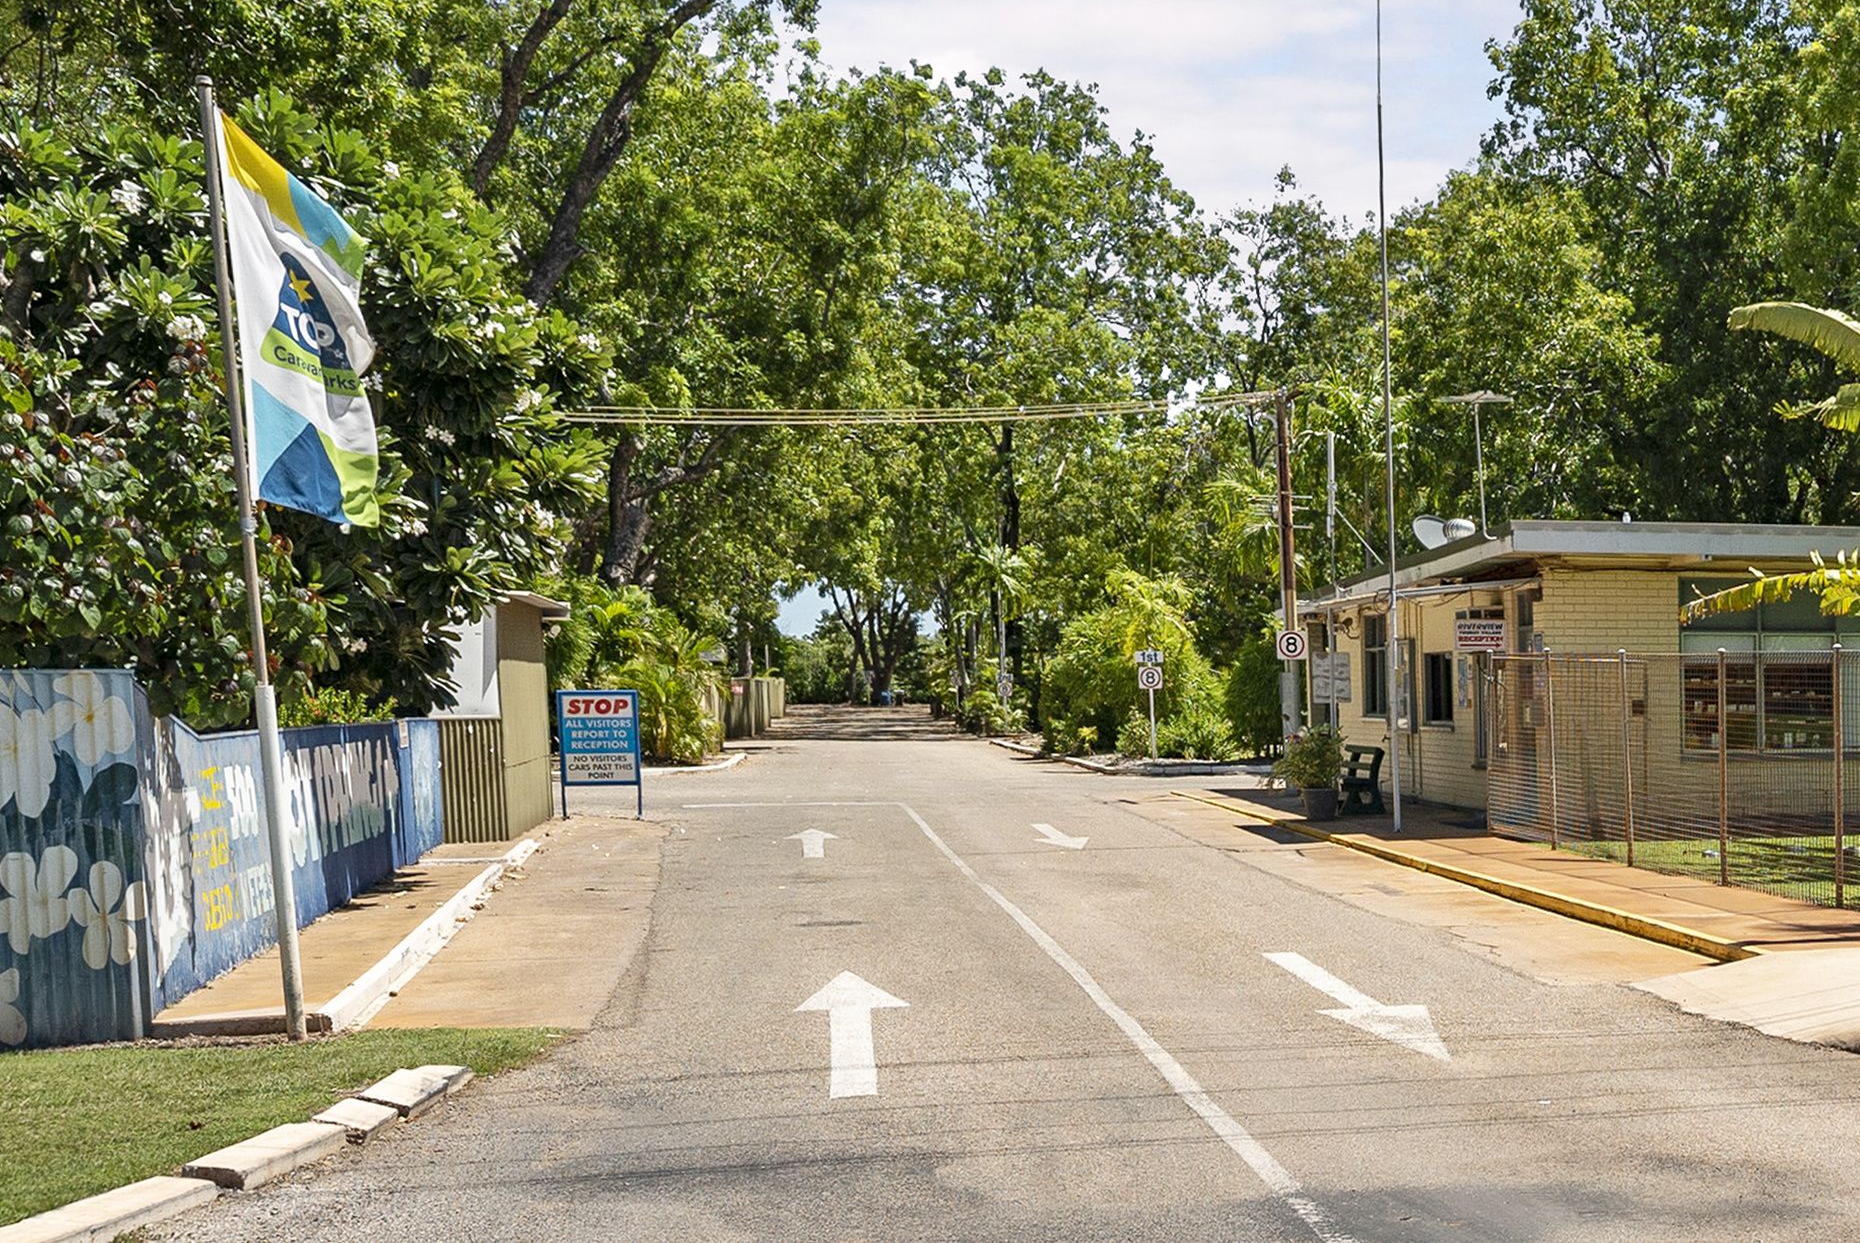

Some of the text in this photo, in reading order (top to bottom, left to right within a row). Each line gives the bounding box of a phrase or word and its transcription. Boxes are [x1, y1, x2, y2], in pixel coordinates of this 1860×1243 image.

[1286, 637, 1297, 653] 8
[1140, 652, 1158, 662] 1st
[1145, 671, 1155, 684] 8
[567, 699, 629, 714] STOP
[566, 719, 632, 728] ALL VISITORS
[571, 730, 627, 738] REPORT TO
[571, 741, 628, 749] RECEPTION
[568, 763, 591, 771] CARS
[592, 763, 612, 771] PAST
